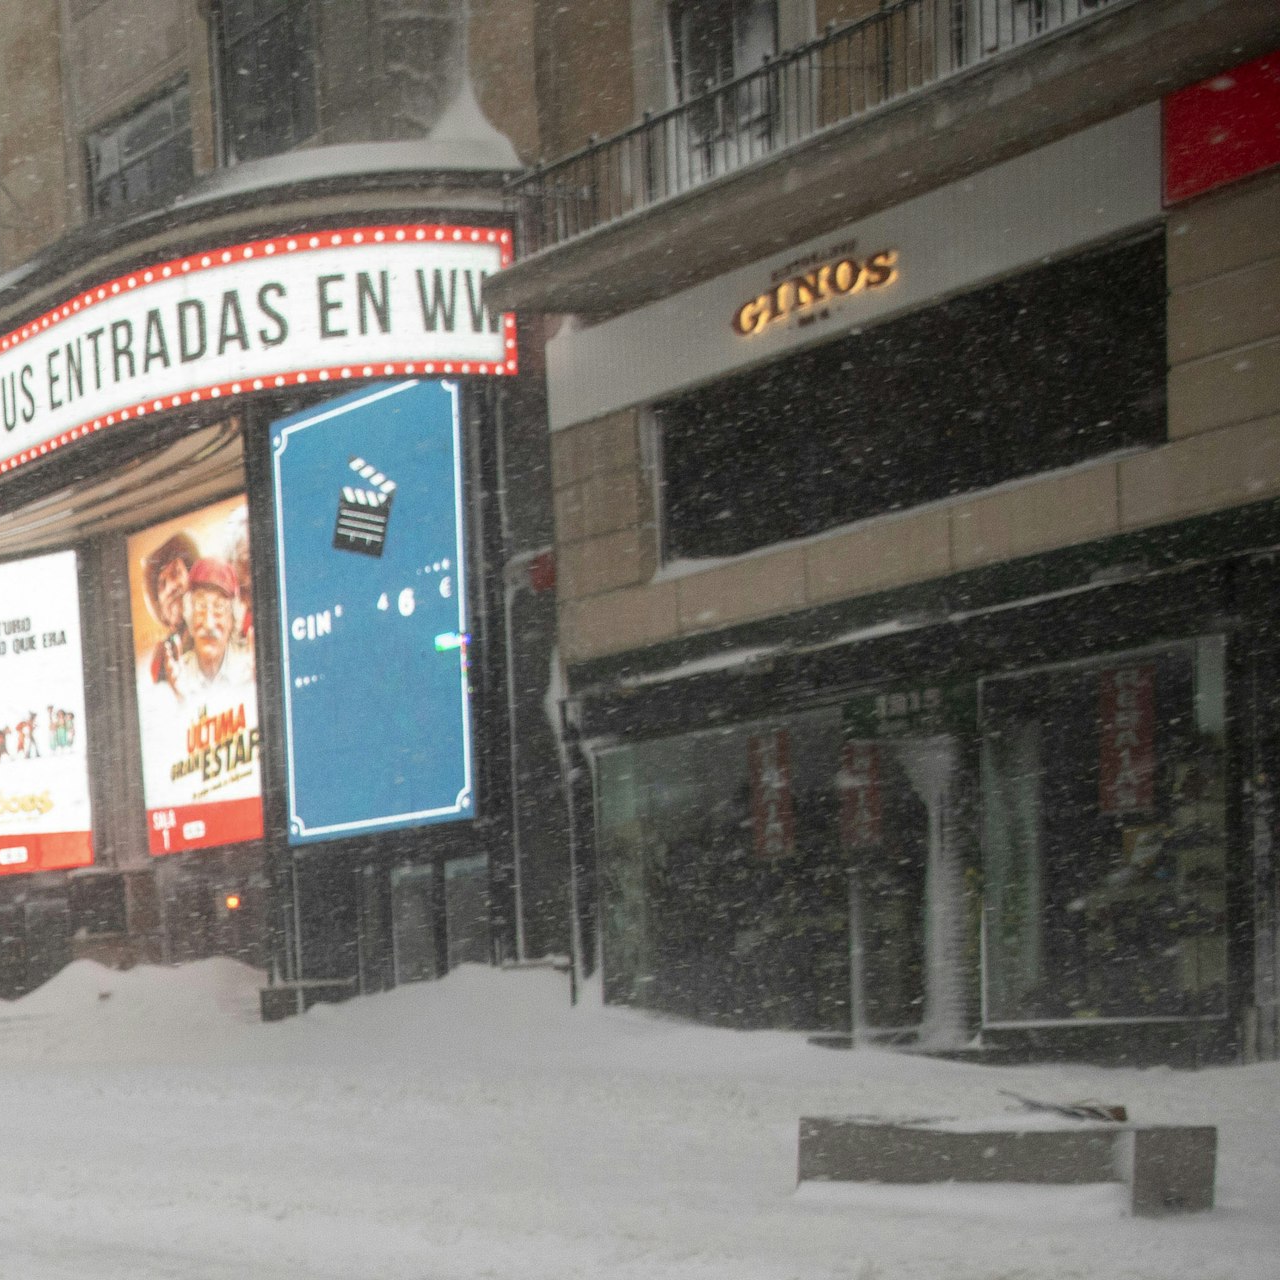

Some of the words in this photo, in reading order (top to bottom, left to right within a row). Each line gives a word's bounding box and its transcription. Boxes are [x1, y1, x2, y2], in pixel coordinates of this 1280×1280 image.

[732, 250, 900, 335] GINOS
[46, 281, 290, 412] ENTRADAS
[316, 270, 393, 340] EN
[12, 634, 37, 655] QUE
[42, 630, 68, 649] ERA
[152, 809, 177, 831] SALA
